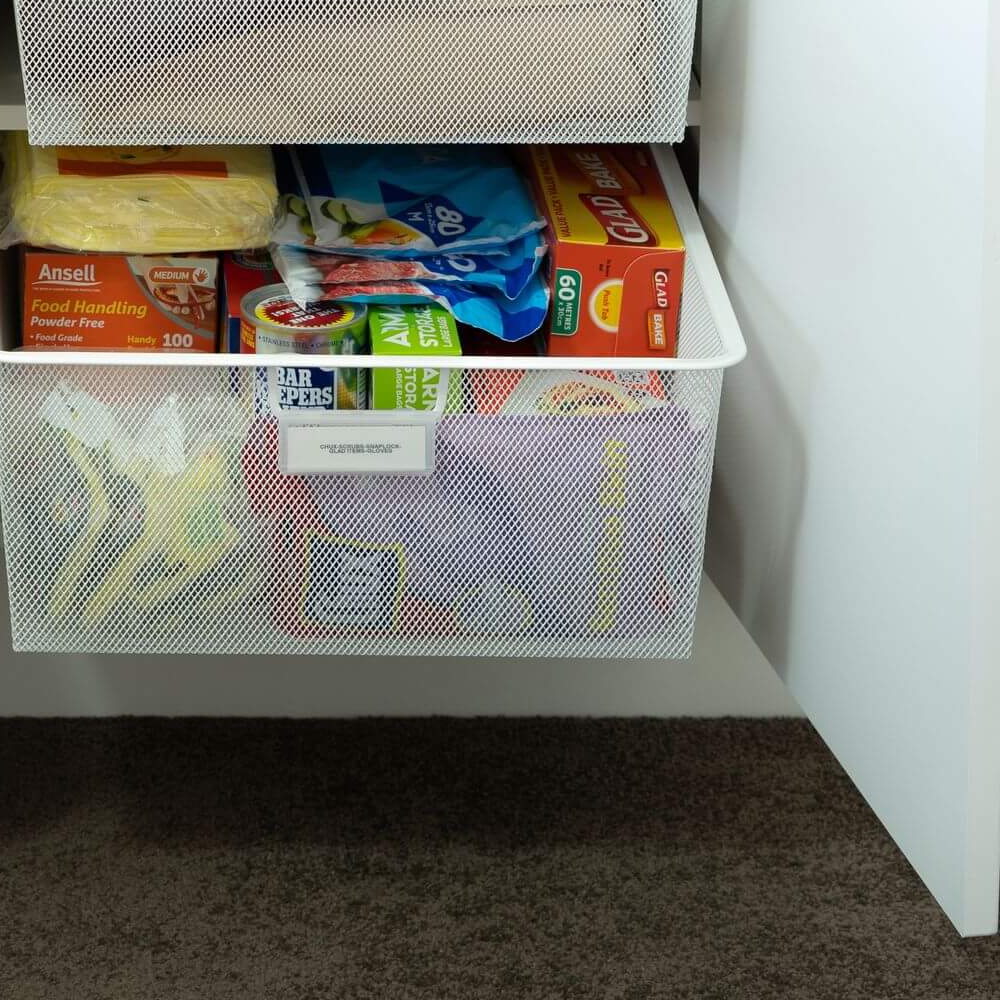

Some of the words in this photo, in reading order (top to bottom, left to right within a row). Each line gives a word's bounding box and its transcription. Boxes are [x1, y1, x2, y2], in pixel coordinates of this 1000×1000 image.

[576, 152, 623, 189] BAKE
[434, 205, 465, 236] 80
[591, 196, 649, 243] GLAD
[39, 263, 95, 281] Ansell
[153, 271, 189, 280] MEDIUM
[558, 275, 576, 301] 60
[601, 289, 609, 305] Push
[655, 271, 669, 307] GLAD
[32, 299, 70, 313] Food
[74, 300, 147, 318] Handling
[564, 301, 572, 330] METRES
[601, 306, 609, 320] Tab
[30, 316, 76, 327] Powder
[79, 317, 105, 328] Free
[653, 313, 664, 345] BAKE
[35, 333, 56, 342] Food
[58, 333, 83, 342] Grade
[127, 335, 157, 345] Handy
[162, 333, 193, 347] 100
[277, 367, 312, 387] BAR
[278, 386, 333, 406] EPERS
